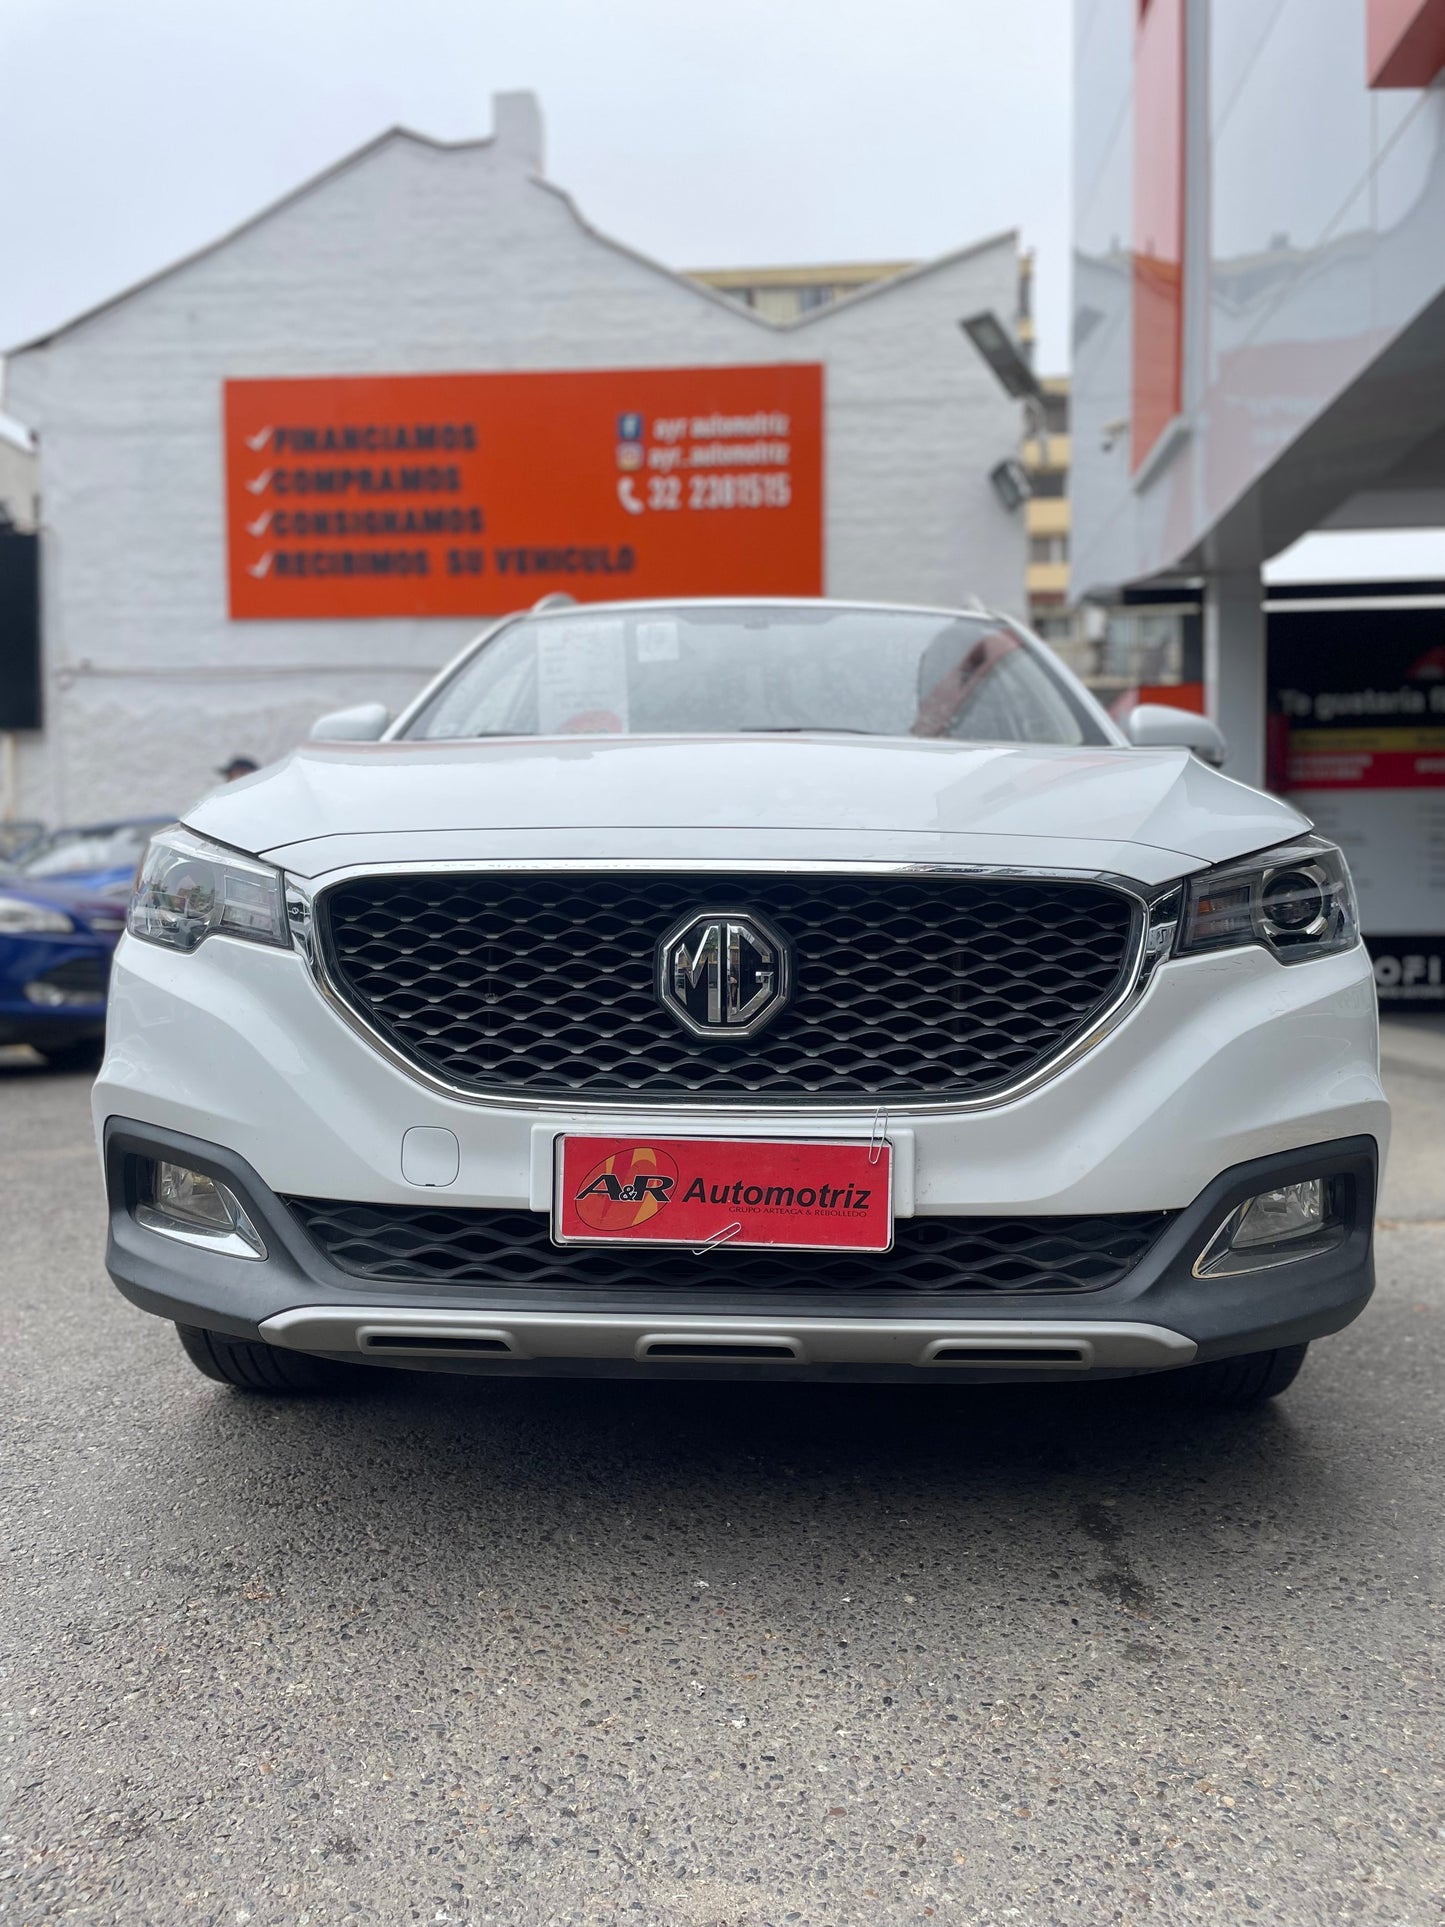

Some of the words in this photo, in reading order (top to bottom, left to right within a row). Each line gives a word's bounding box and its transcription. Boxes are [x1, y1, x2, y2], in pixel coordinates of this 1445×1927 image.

[275, 424, 477, 453] FINANCIAMOS
[274, 465, 461, 493] COMPRAMOS
[648, 475, 681, 510] 32
[273, 507, 484, 536] CONSIGNAMOS
[274, 549, 429, 577] RECIBIMOS
[447, 548, 482, 575] SU
[675, 923, 774, 1022] MG
[574, 1174, 674, 1203] A&R
[682, 1177, 871, 1210] Automotriz
[728, 1206, 761, 1214] GRUPO
